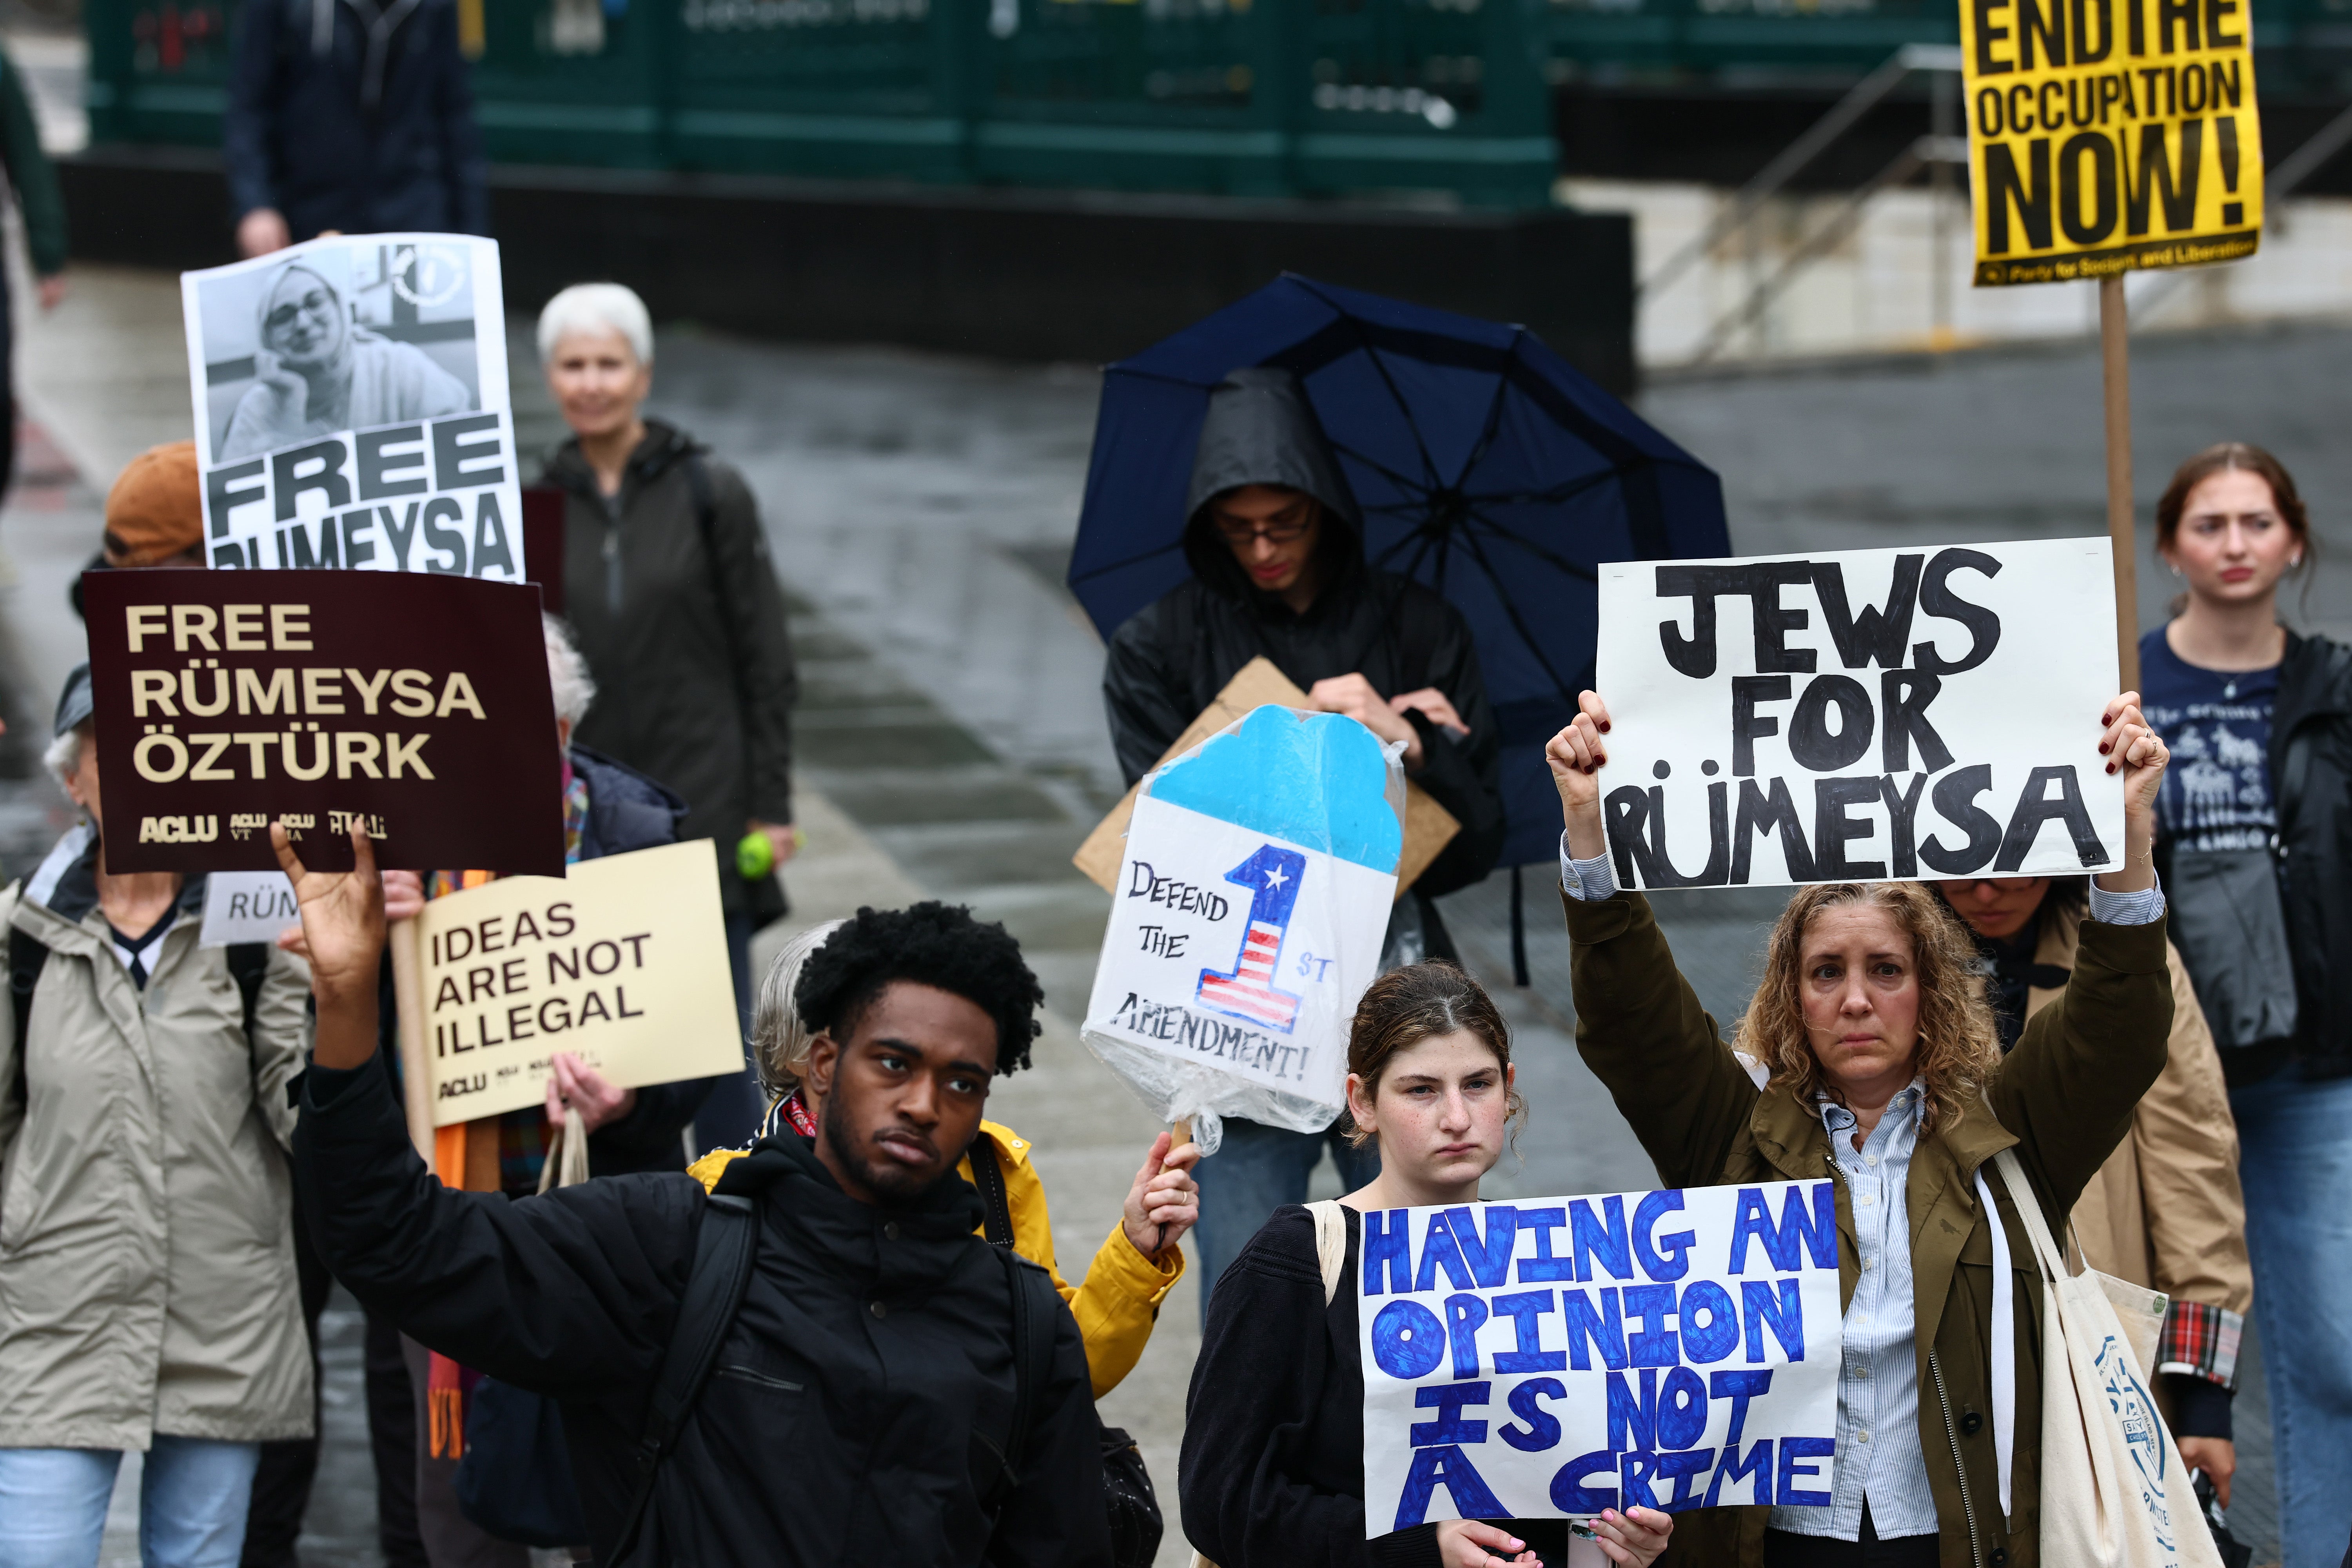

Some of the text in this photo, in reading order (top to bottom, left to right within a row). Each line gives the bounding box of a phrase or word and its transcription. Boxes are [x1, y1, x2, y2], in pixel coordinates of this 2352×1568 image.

[1973, 0, 2112, 75] END
[1978, 60, 2240, 136] OCCUPATION
[1984, 116, 2243, 255] NOW!
[2010, 265, 2054, 281] Party
[2055, 260, 2078, 278] for
[2140, 246, 2174, 268] and
[2175, 239, 2255, 263] Liberation
[207, 412, 505, 538] FREE
[125, 604, 313, 653] FREE
[1655, 548, 2002, 679] JEWS
[130, 659, 487, 720] RÜMEYSA
[1732, 668, 1955, 777] FOR
[133, 723, 436, 783] ÖZTÜRK
[139, 815, 219, 844] ACLU
[230, 813, 267, 828] ACLU
[230, 829, 252, 841] VT
[278, 813, 316, 829] ACLU
[1604, 759, 2110, 889] RÜMEYSA
[1129, 860, 1228, 921] DEFEND
[433, 902, 575, 966] IDEAS
[1139, 926, 1189, 958] THE
[434, 933, 652, 1012] ARE NOT
[437, 986, 644, 1058] ILLEGAL
[1109, 993, 1311, 1081] AMENDMENT!
[439, 1073, 486, 1100] ACLU
[1364, 1183, 1838, 1296] HAVING AN
[1371, 1278, 1805, 1380] OPINION
[1410, 1366, 1773, 1452] IS NOT
[2143, 1415, 2152, 1434] ISLAND
[1393, 1437, 1835, 1532] A CRIME
